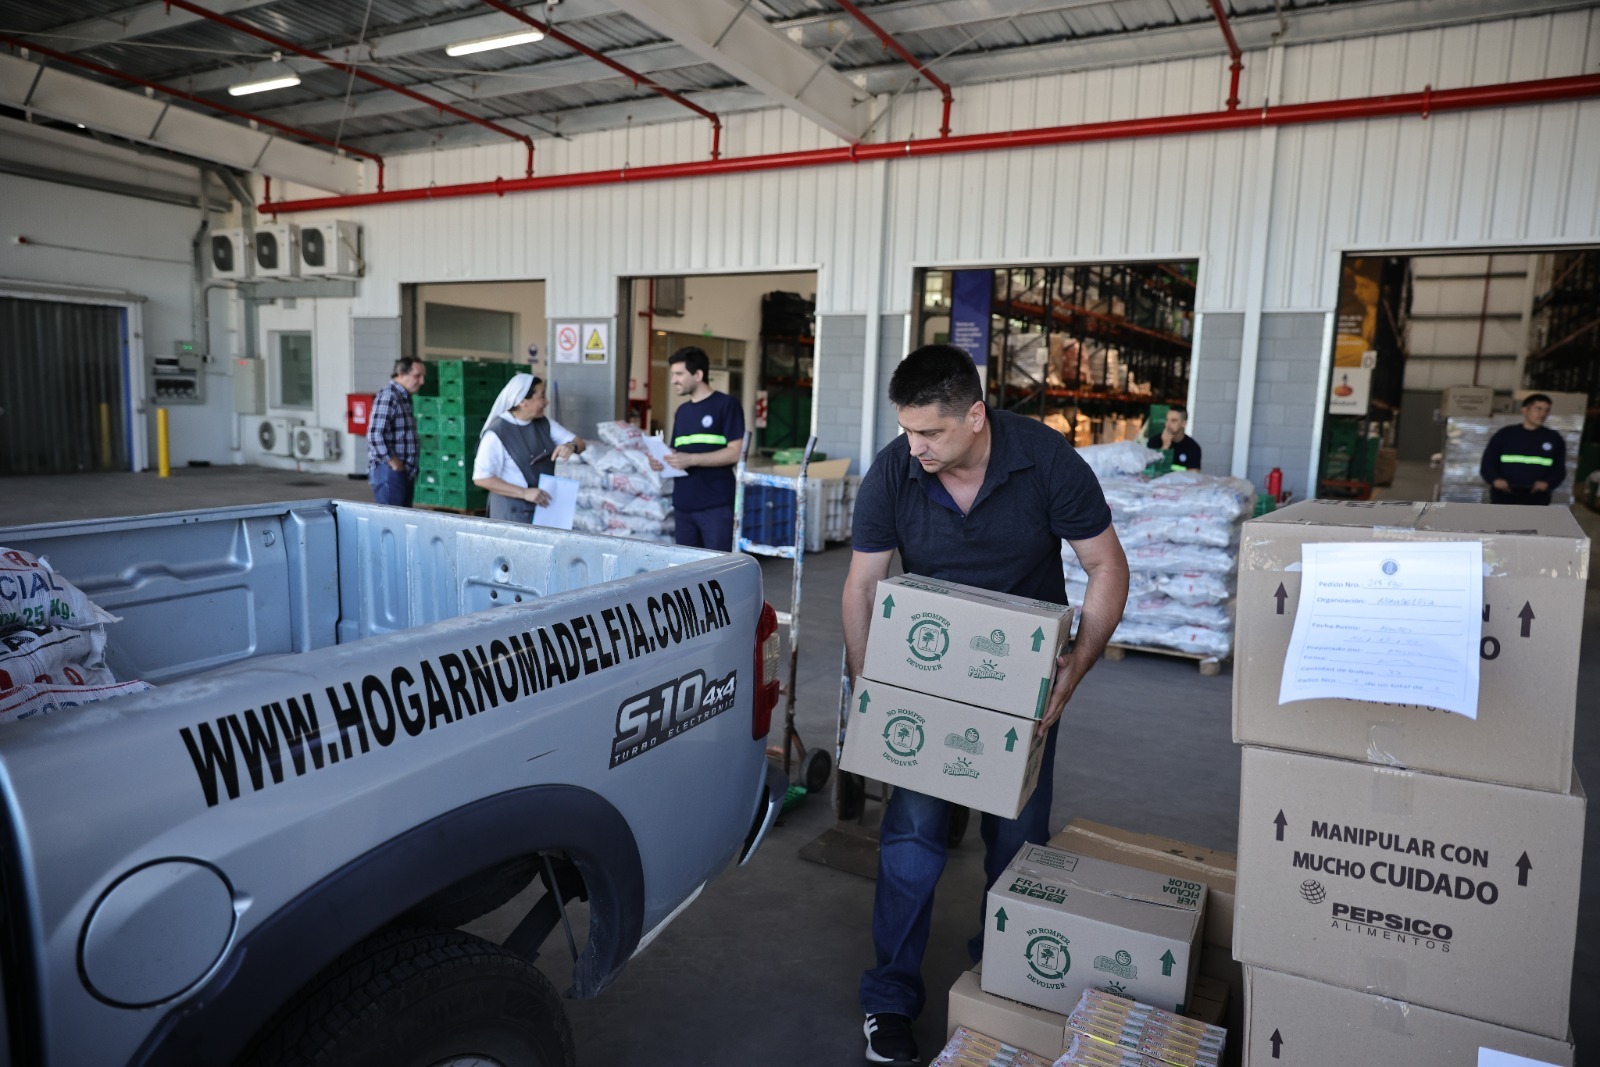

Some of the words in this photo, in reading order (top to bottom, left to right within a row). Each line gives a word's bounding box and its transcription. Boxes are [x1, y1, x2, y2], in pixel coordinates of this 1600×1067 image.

[1316, 597, 1366, 605] Organización:
[23, 605, 44, 626] 25
[911, 613, 921, 621] NO
[922, 612, 950, 627] ROMPER
[906, 657, 943, 671] DEVOLVER
[179, 579, 731, 807] WWW.HOGARNOMADELFIA.COM.AR
[615, 671, 705, 753] S-10
[702, 676, 735, 707] 4x4
[886, 709, 896, 717] NO
[898, 708, 926, 724] ROMPER
[614, 737, 657, 763] TURBO
[668, 698, 734, 738] ELECTRONIC
[882, 751, 918, 766] DEVOLVER
[1311, 820, 1435, 859] MANIPULAR
[1440, 843, 1489, 868] CON
[1016, 877, 1068, 897] FRAGIL
[1168, 878, 1202, 892] COLOR
[1292, 850, 1365, 880] MUCHO
[1370, 861, 1499, 905] CUIDADO
[1332, 902, 1453, 941] PEPSICO
[1026, 928, 1037, 936] NO
[1038, 927, 1071, 945] ROMPER
[1331, 919, 1451, 953] ALIMENTOS
[1026, 973, 1067, 989] DEVOLVER
